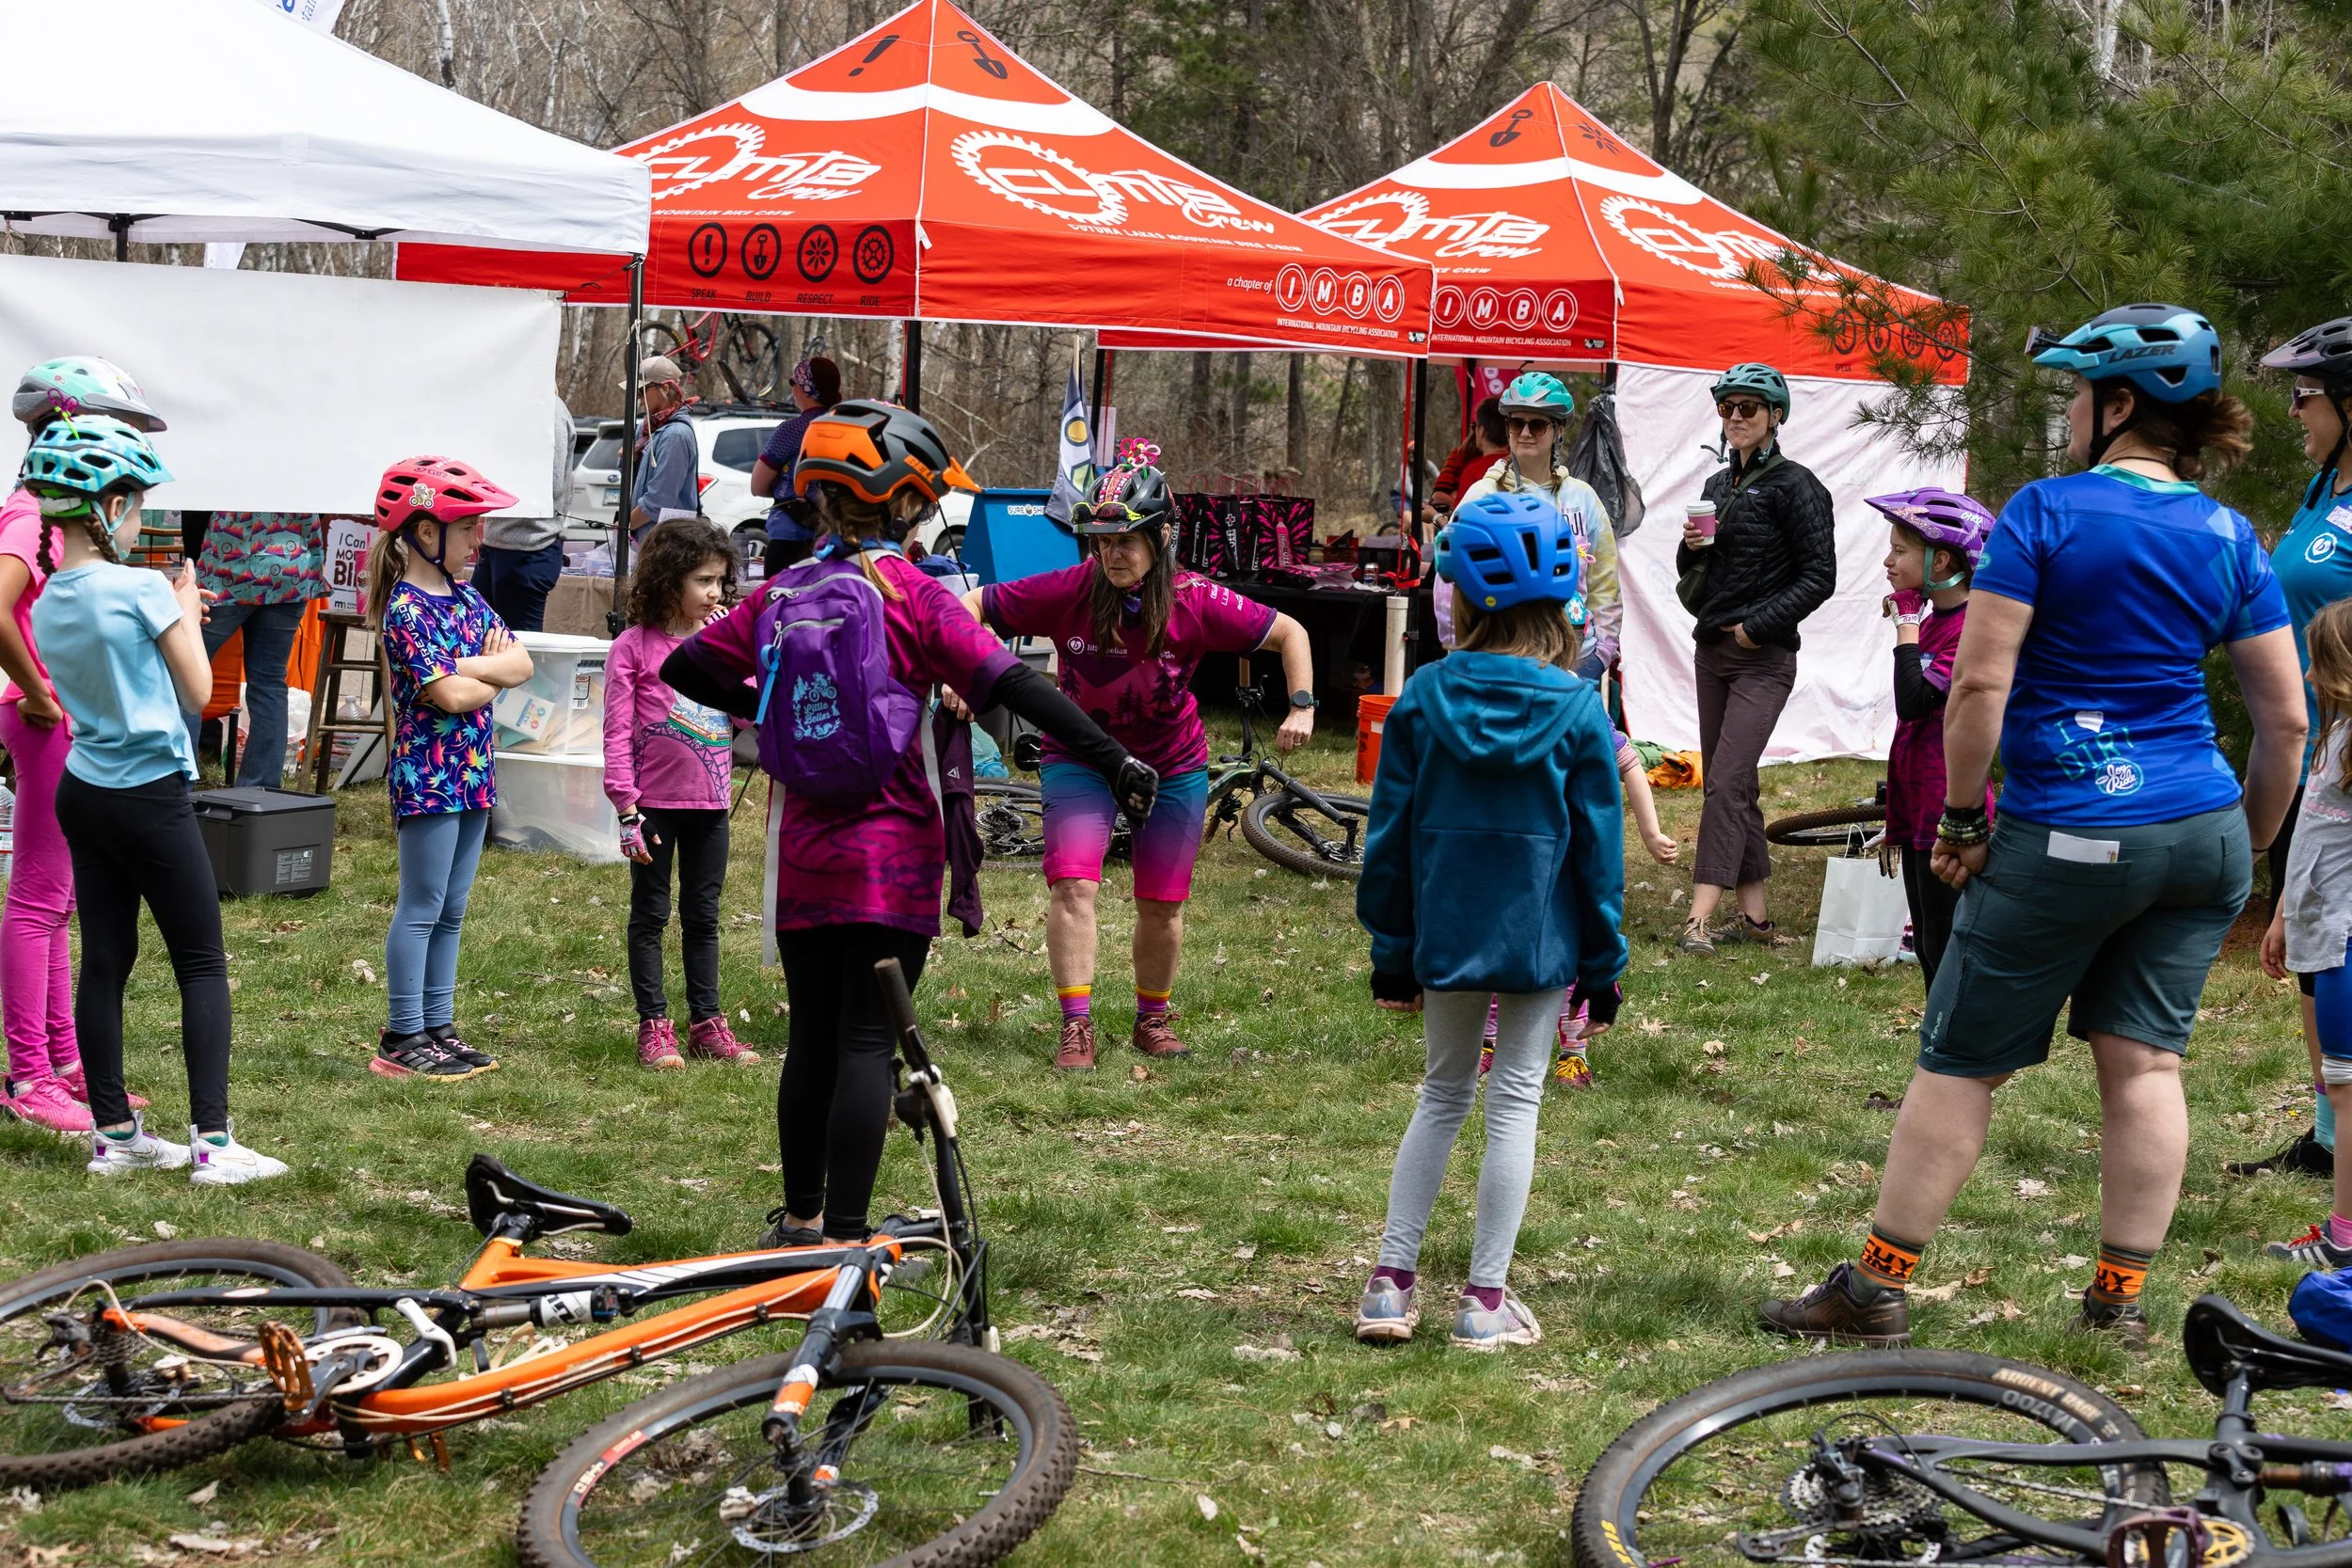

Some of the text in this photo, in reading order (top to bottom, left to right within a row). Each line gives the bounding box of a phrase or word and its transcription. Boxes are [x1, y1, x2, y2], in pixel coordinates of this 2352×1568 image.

[1124, 230, 1166, 239] LAKES
[1227, 277, 1232, 286] a
[1233, 277, 1263, 293] chapter
[1263, 280, 1273, 294] of
[691, 288, 881, 307] SPEAK BUILD RESPECT RIDE
[1277, 318, 1314, 330] INTERNATIONAL
[1315, 323, 1342, 332] MOUNTAIN
[1342, 325, 1367, 336] BICYCLING
[1367, 327, 1398, 339] ASSOCIATION
[1431, 334, 1475, 343] INTERNATIONAL
[1475, 336, 1504, 344] MOUNTAIN
[1505, 337, 1534, 345] BICYCLING
[1534, 339, 1571, 347] ASSOCIATION
[2107, 344, 2176, 364] LAZER
[1008, 505, 1045, 515] SURE SHI
[339, 532, 366, 549] I Can
[398, 605, 434, 666] PREVELO
[803, 702, 829, 715] Little
[804, 712, 832, 724] Bellas
[2096, 1265, 2134, 1285] UY
[1992, 1367, 2066, 1401] ARDENT
[2002, 1388, 2079, 1435] M1700
